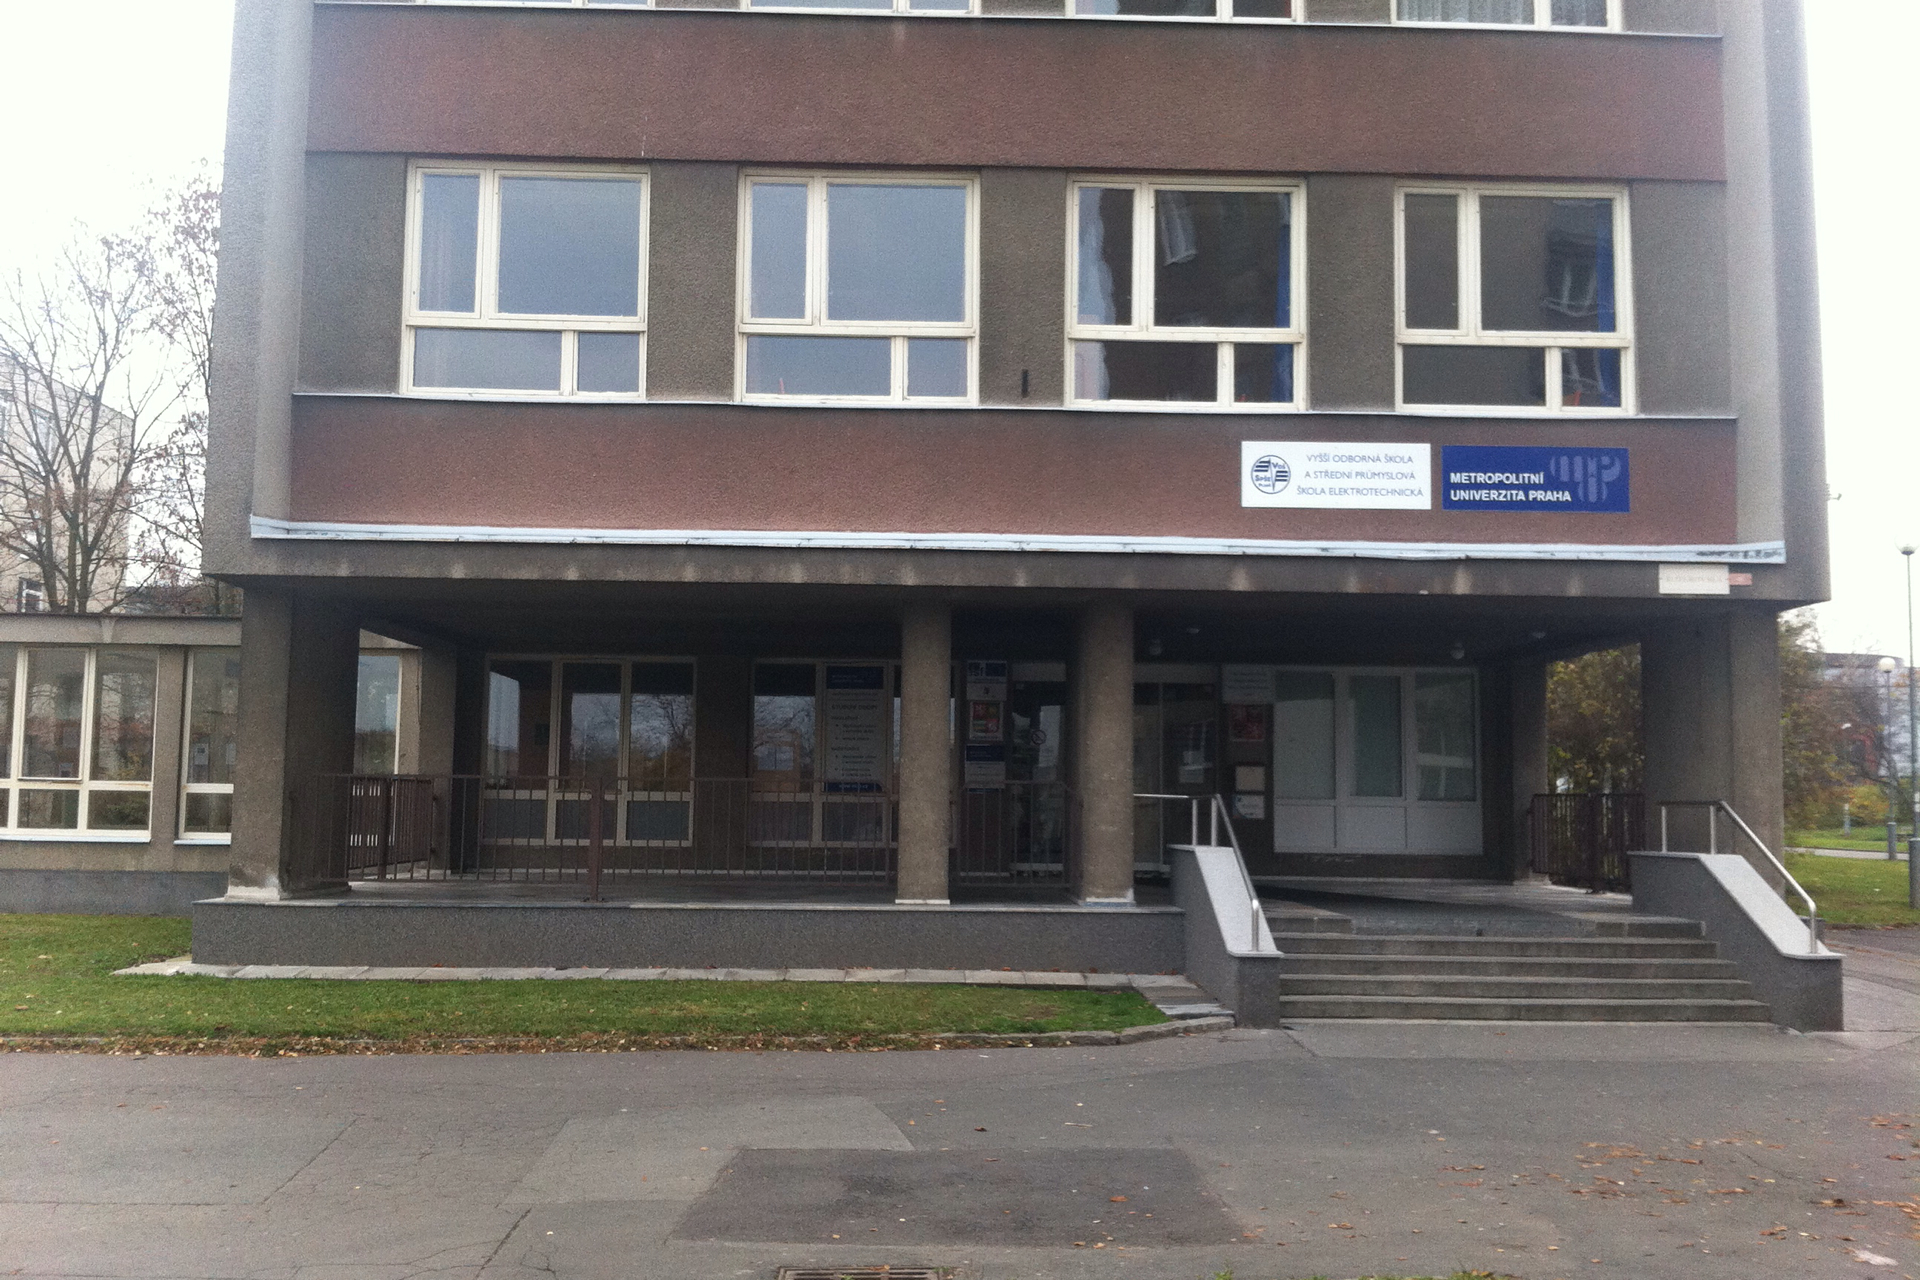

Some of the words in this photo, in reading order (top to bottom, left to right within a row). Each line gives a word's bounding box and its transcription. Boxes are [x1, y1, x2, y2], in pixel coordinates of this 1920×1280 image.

[1306, 452, 1330, 463] VYŠŠÍ
[1332, 453, 1382, 463] ODBORNÁ
[1384, 453, 1413, 464] ŠKOLA
[1304, 471, 1311, 479] A
[1314, 469, 1353, 480] STŘEDNÍ
[1355, 470, 1416, 480] PRŮMYSLOVÁ
[1450, 472, 1544, 484] METROPOLITNÍ
[1296, 485, 1326, 496] ŠKOLA
[1329, 487, 1424, 497] ELEKTROTECHNICKÁ
[1450, 489, 1526, 501] UNIVERZITA
[1528, 490, 1572, 501] PRAHA
